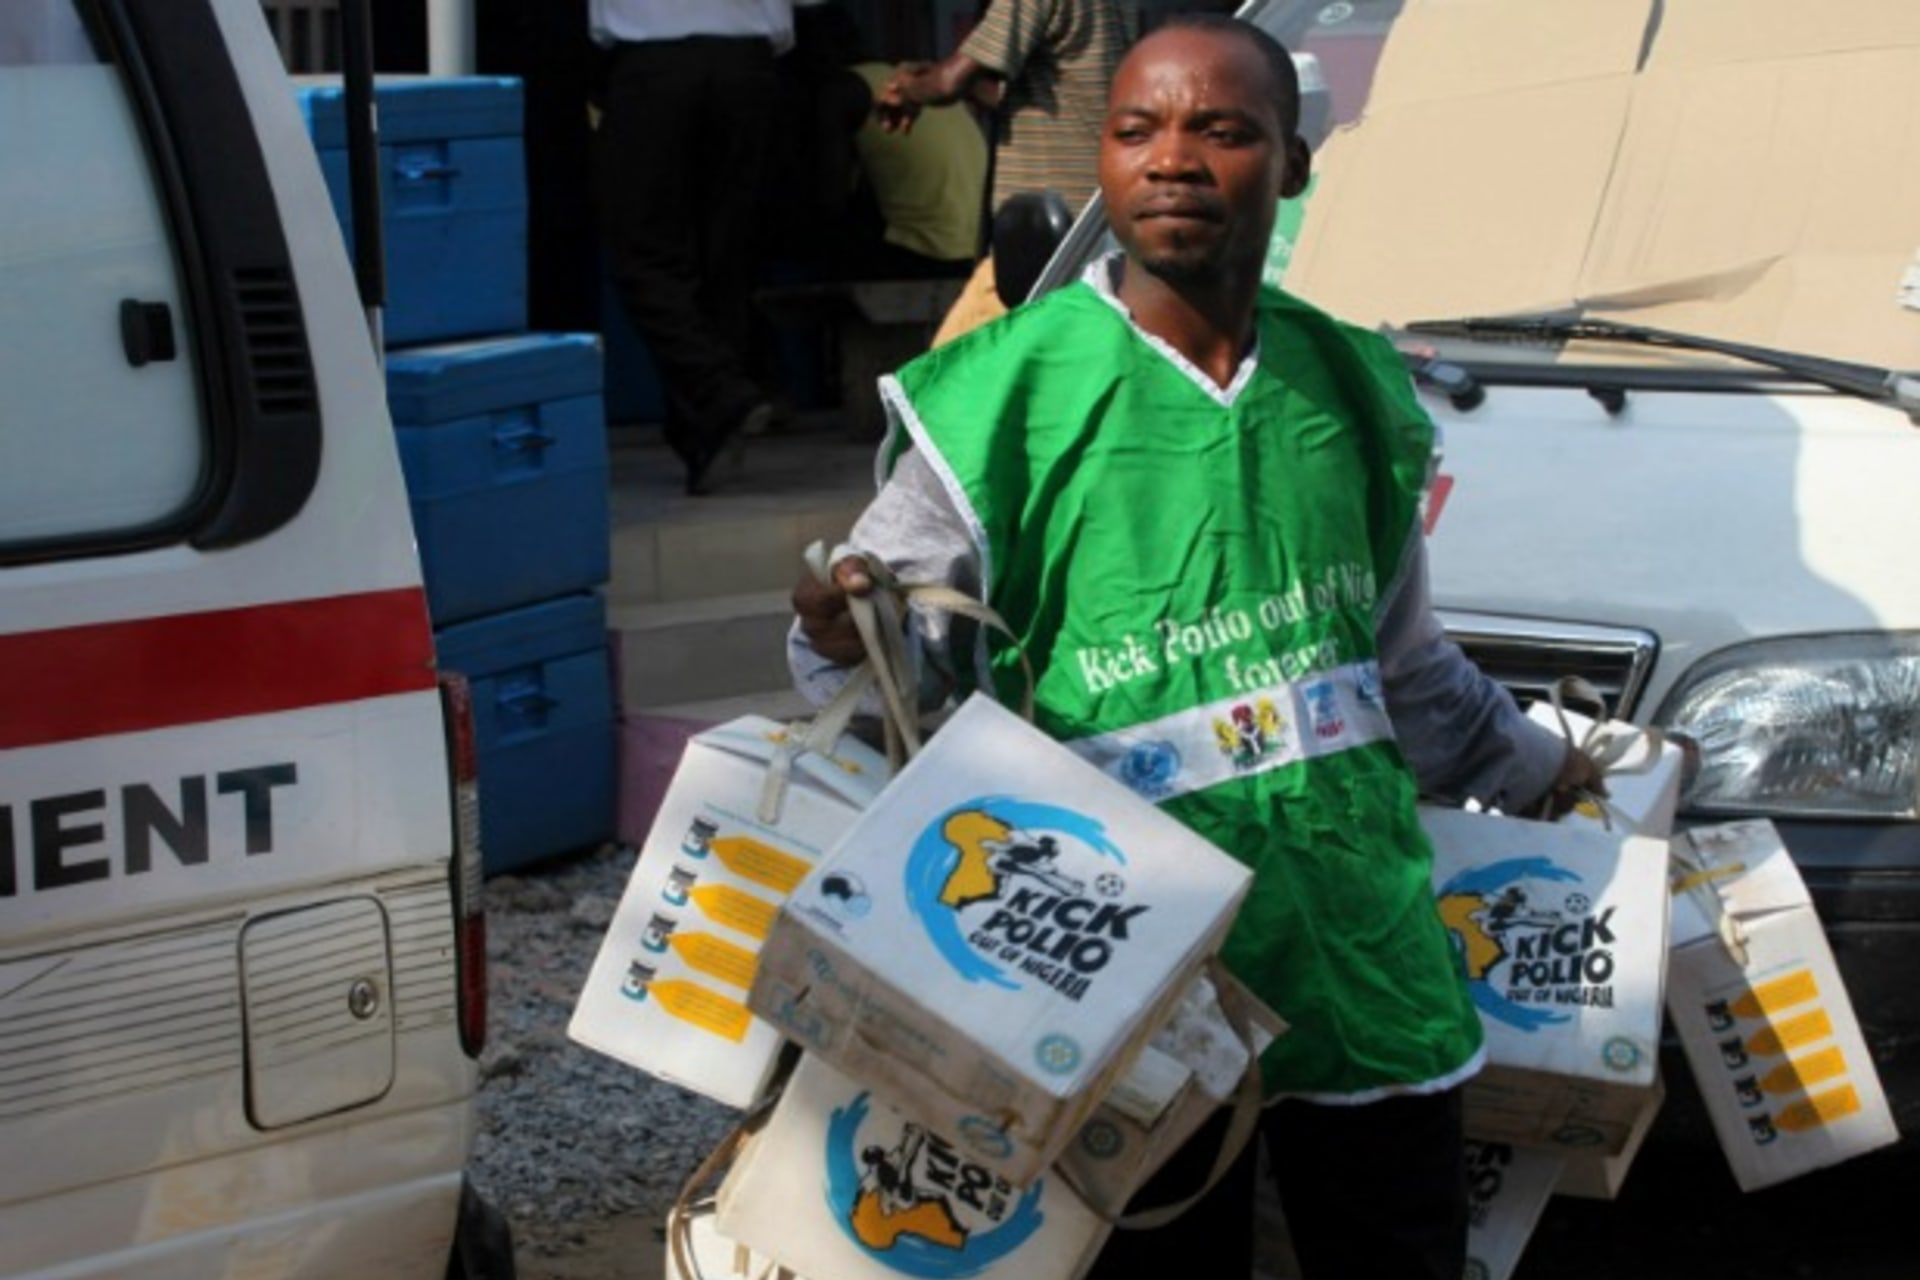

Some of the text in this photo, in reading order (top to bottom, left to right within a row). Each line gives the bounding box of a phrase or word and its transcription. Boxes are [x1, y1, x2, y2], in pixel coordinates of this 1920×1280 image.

[1076, 633, 1158, 693] Kick
[981, 908, 1113, 975] POLIO
[1004, 887, 1152, 942] KICK
[1515, 904, 1618, 961] KICK
[1508, 948, 1614, 987] POLIO
